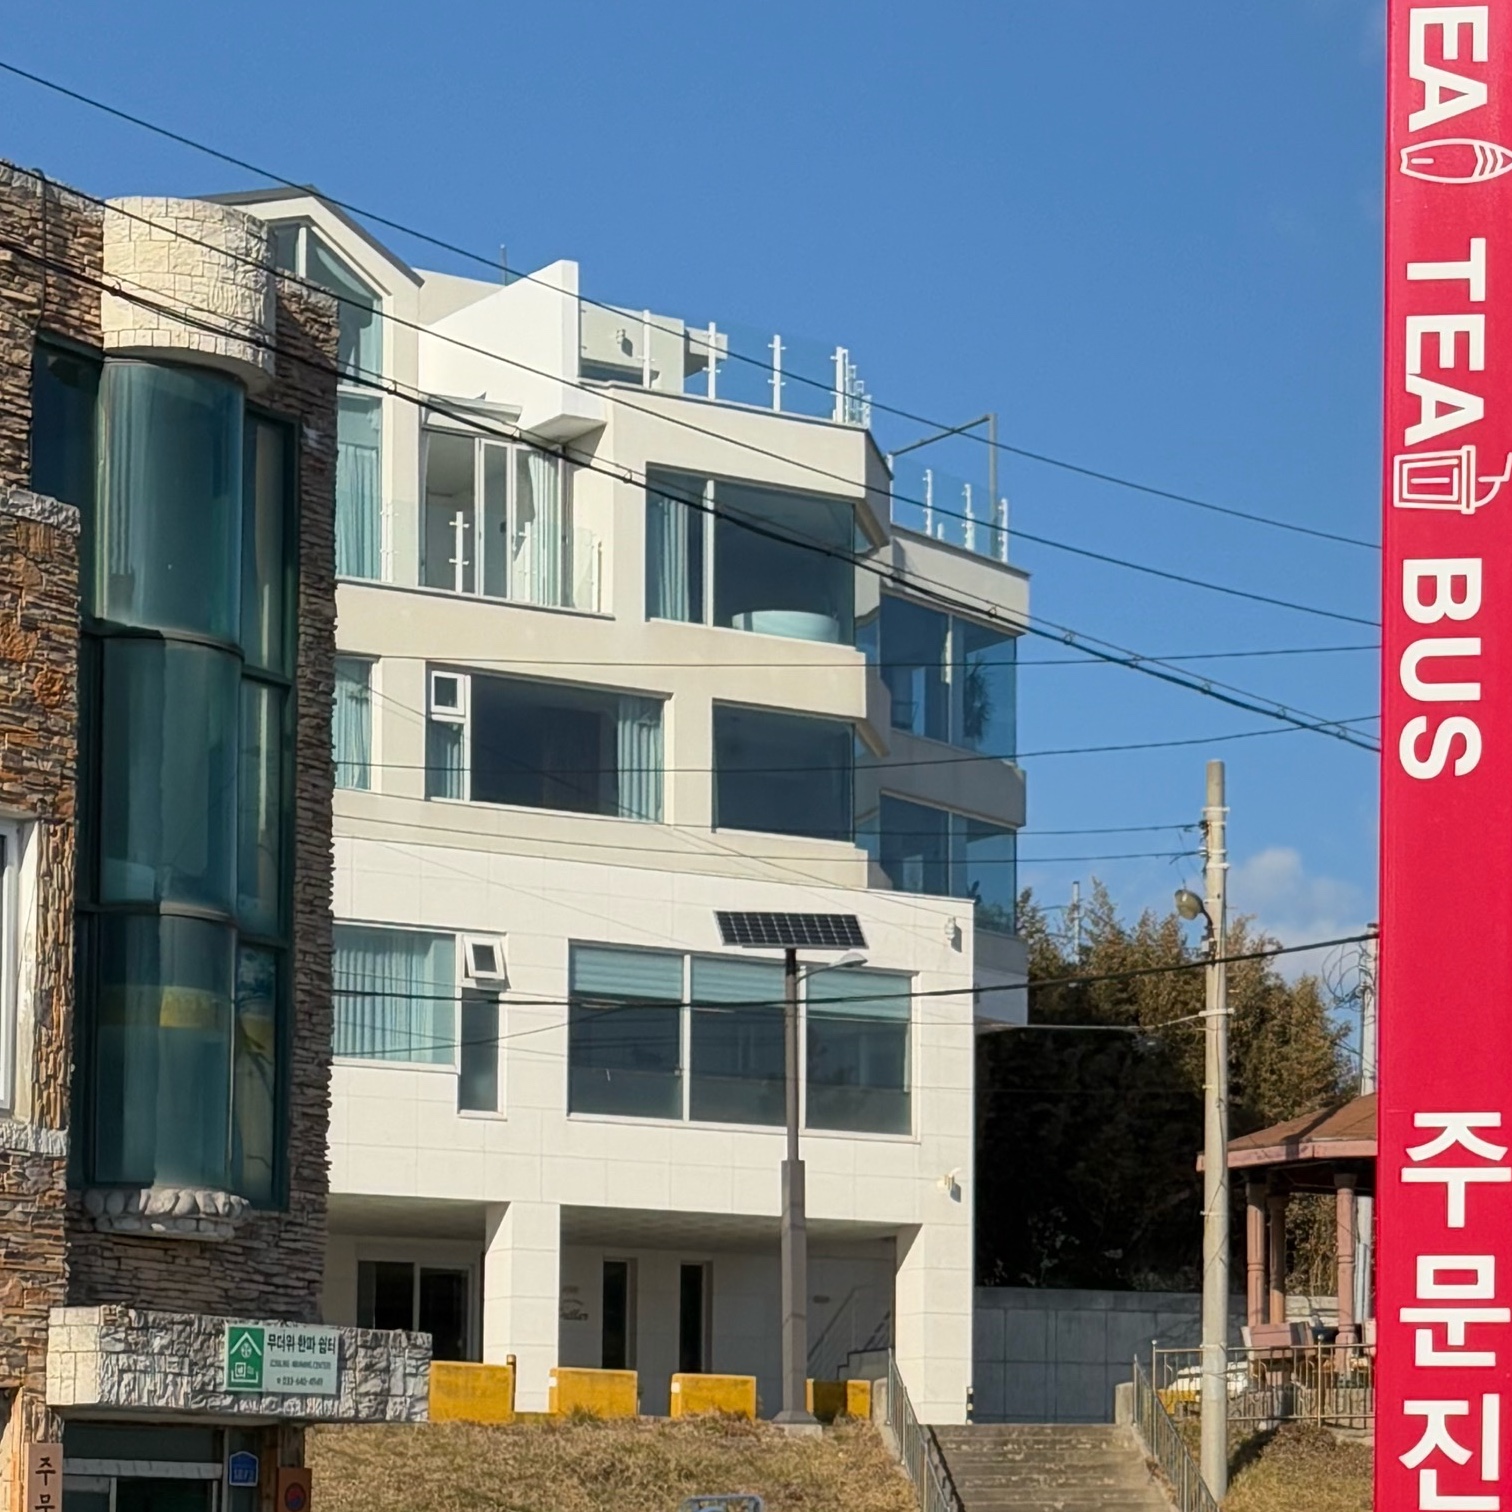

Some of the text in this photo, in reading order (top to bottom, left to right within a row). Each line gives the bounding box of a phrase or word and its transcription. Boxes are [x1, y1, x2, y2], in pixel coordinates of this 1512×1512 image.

[1404, 237, 1487, 447] TEA
[1398, 557, 1483, 780] BUS
[267, 1332, 337, 1355] 무더위 한파 쉼터
